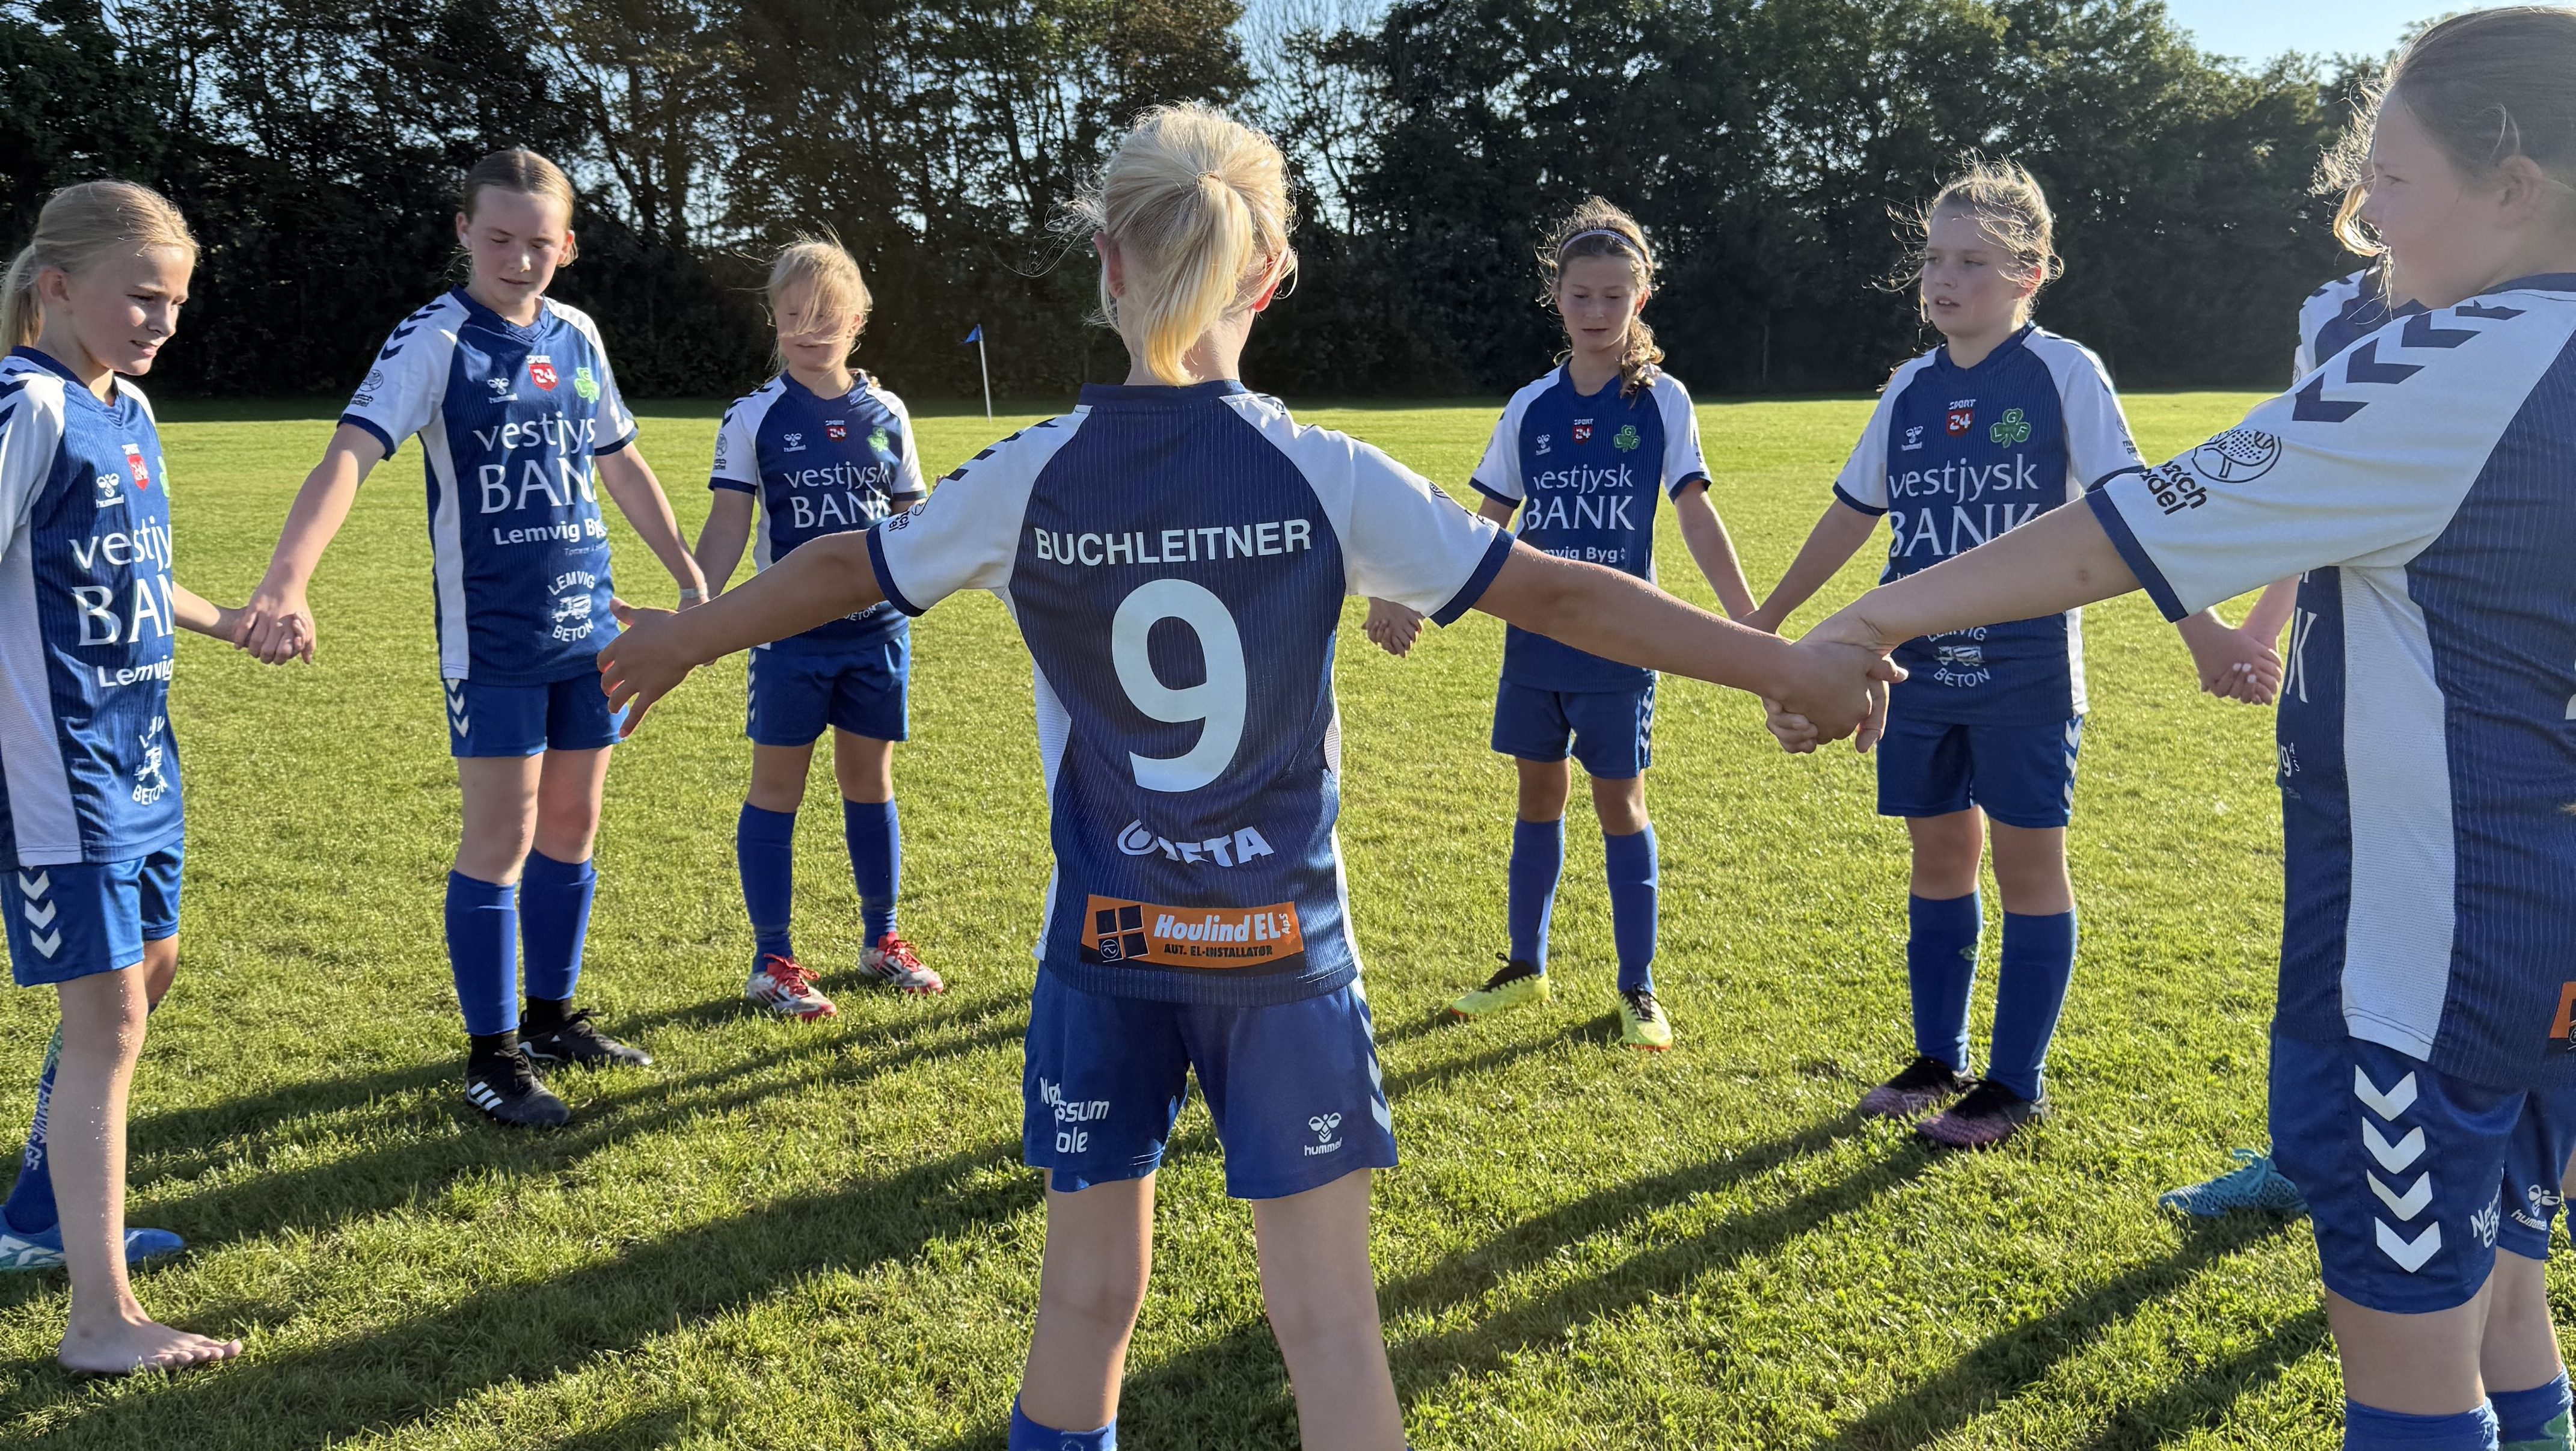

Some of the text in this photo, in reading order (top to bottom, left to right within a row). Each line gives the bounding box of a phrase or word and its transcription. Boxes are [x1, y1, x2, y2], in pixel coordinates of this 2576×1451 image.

[533, 368, 557, 384] 24
[1949, 399, 1976, 410] SPORT
[1949, 413, 1970, 431] 24
[2006, 411, 2017, 423] G
[1575, 428, 1591, 440] 24
[1888, 453, 2040, 504] vestjysk
[2159, 461, 2207, 510] atch
[492, 520, 581, 545] Lemvig
[1034, 518, 1311, 566] BUCHLEITNER
[1586, 547, 1618, 563] Byg
[547, 571, 595, 596] LEMVIG
[552, 618, 594, 642] BETON
[97, 654, 174, 688] Lemvig
[1933, 667, 1992, 687] BETON
[1111, 578, 1248, 793] 9
[132, 775, 168, 805] BETON
[1153, 913, 1251, 942] Houlind
[1254, 912, 1281, 941] EL
[1164, 943, 1188, 955] AUT.
